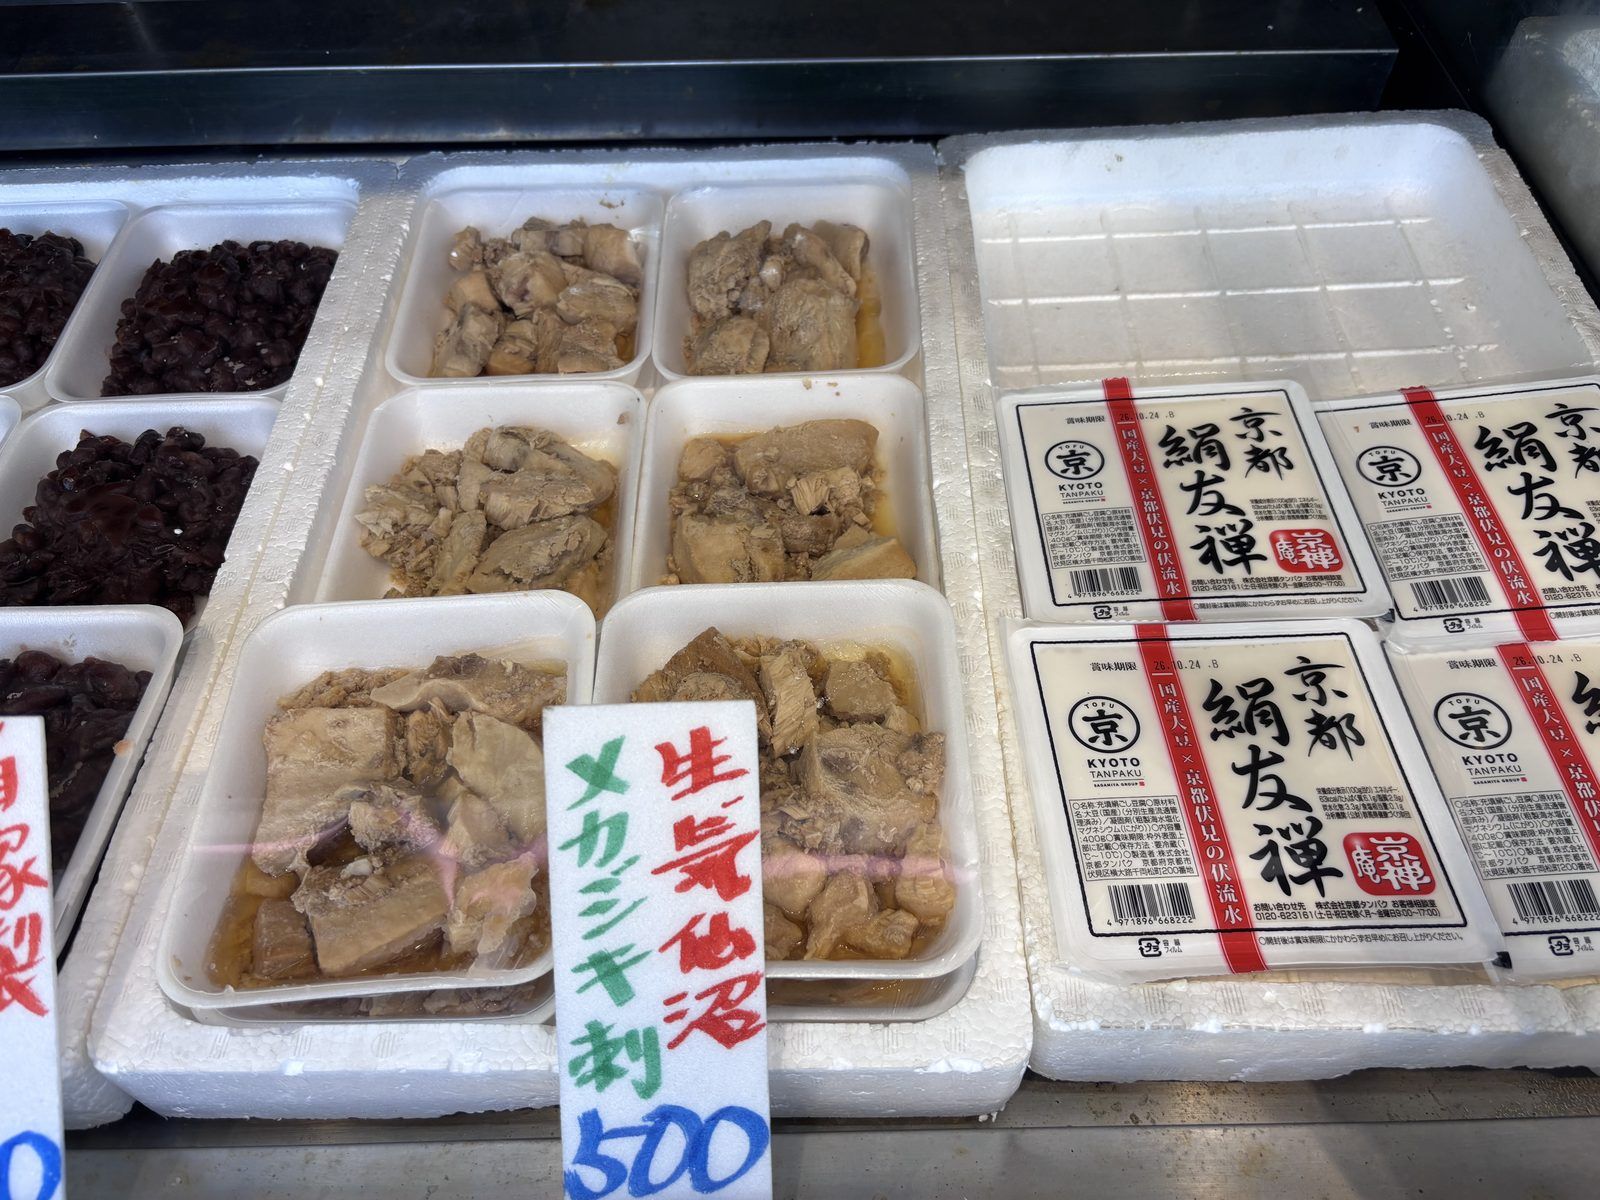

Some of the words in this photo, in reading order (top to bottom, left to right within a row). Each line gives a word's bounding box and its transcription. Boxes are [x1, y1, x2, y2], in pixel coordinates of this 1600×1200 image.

[1229, 407, 1294, 480] 京都
[1368, 449, 1396, 457] TOFU
[1056, 449, 1094, 474] 京
[1368, 455, 1412, 481] 京
[1059, 482, 1103, 490] KYOTO
[1378, 488, 1425, 499] KYOTO
[1158, 424, 1267, 575] 絹友禅
[1381, 497, 1428, 506] TANPAKU
[1091, 662, 1137, 671] 賞味期限
[1448, 657, 1498, 668] 賞味期限
[1449, 698, 1480, 706] TOFU
[1284, 656, 1365, 761] 京都
[1082, 709, 1128, 745] 京
[1449, 706, 1502, 742] 京
[1087, 758, 1140, 768] KYOTO
[1462, 753, 1518, 765] KYOTO
[1090, 770, 1142, 778] TANPAKU
[1467, 766, 1522, 776] TANPAKU
[1203, 678, 1343, 897] 絹友禅
[1254, 903, 1306, 911] お問い合わせ先
[1316, 901, 1388, 910] 株式会社京都タンパク
[1392, 900, 1437, 908] お客様相談室
[1119, 918, 1153, 926] 971896
[1158, 916, 1193, 924] 668222
[1524, 915, 1561, 925] 971896
[563, 1104, 770, 1200] 500
